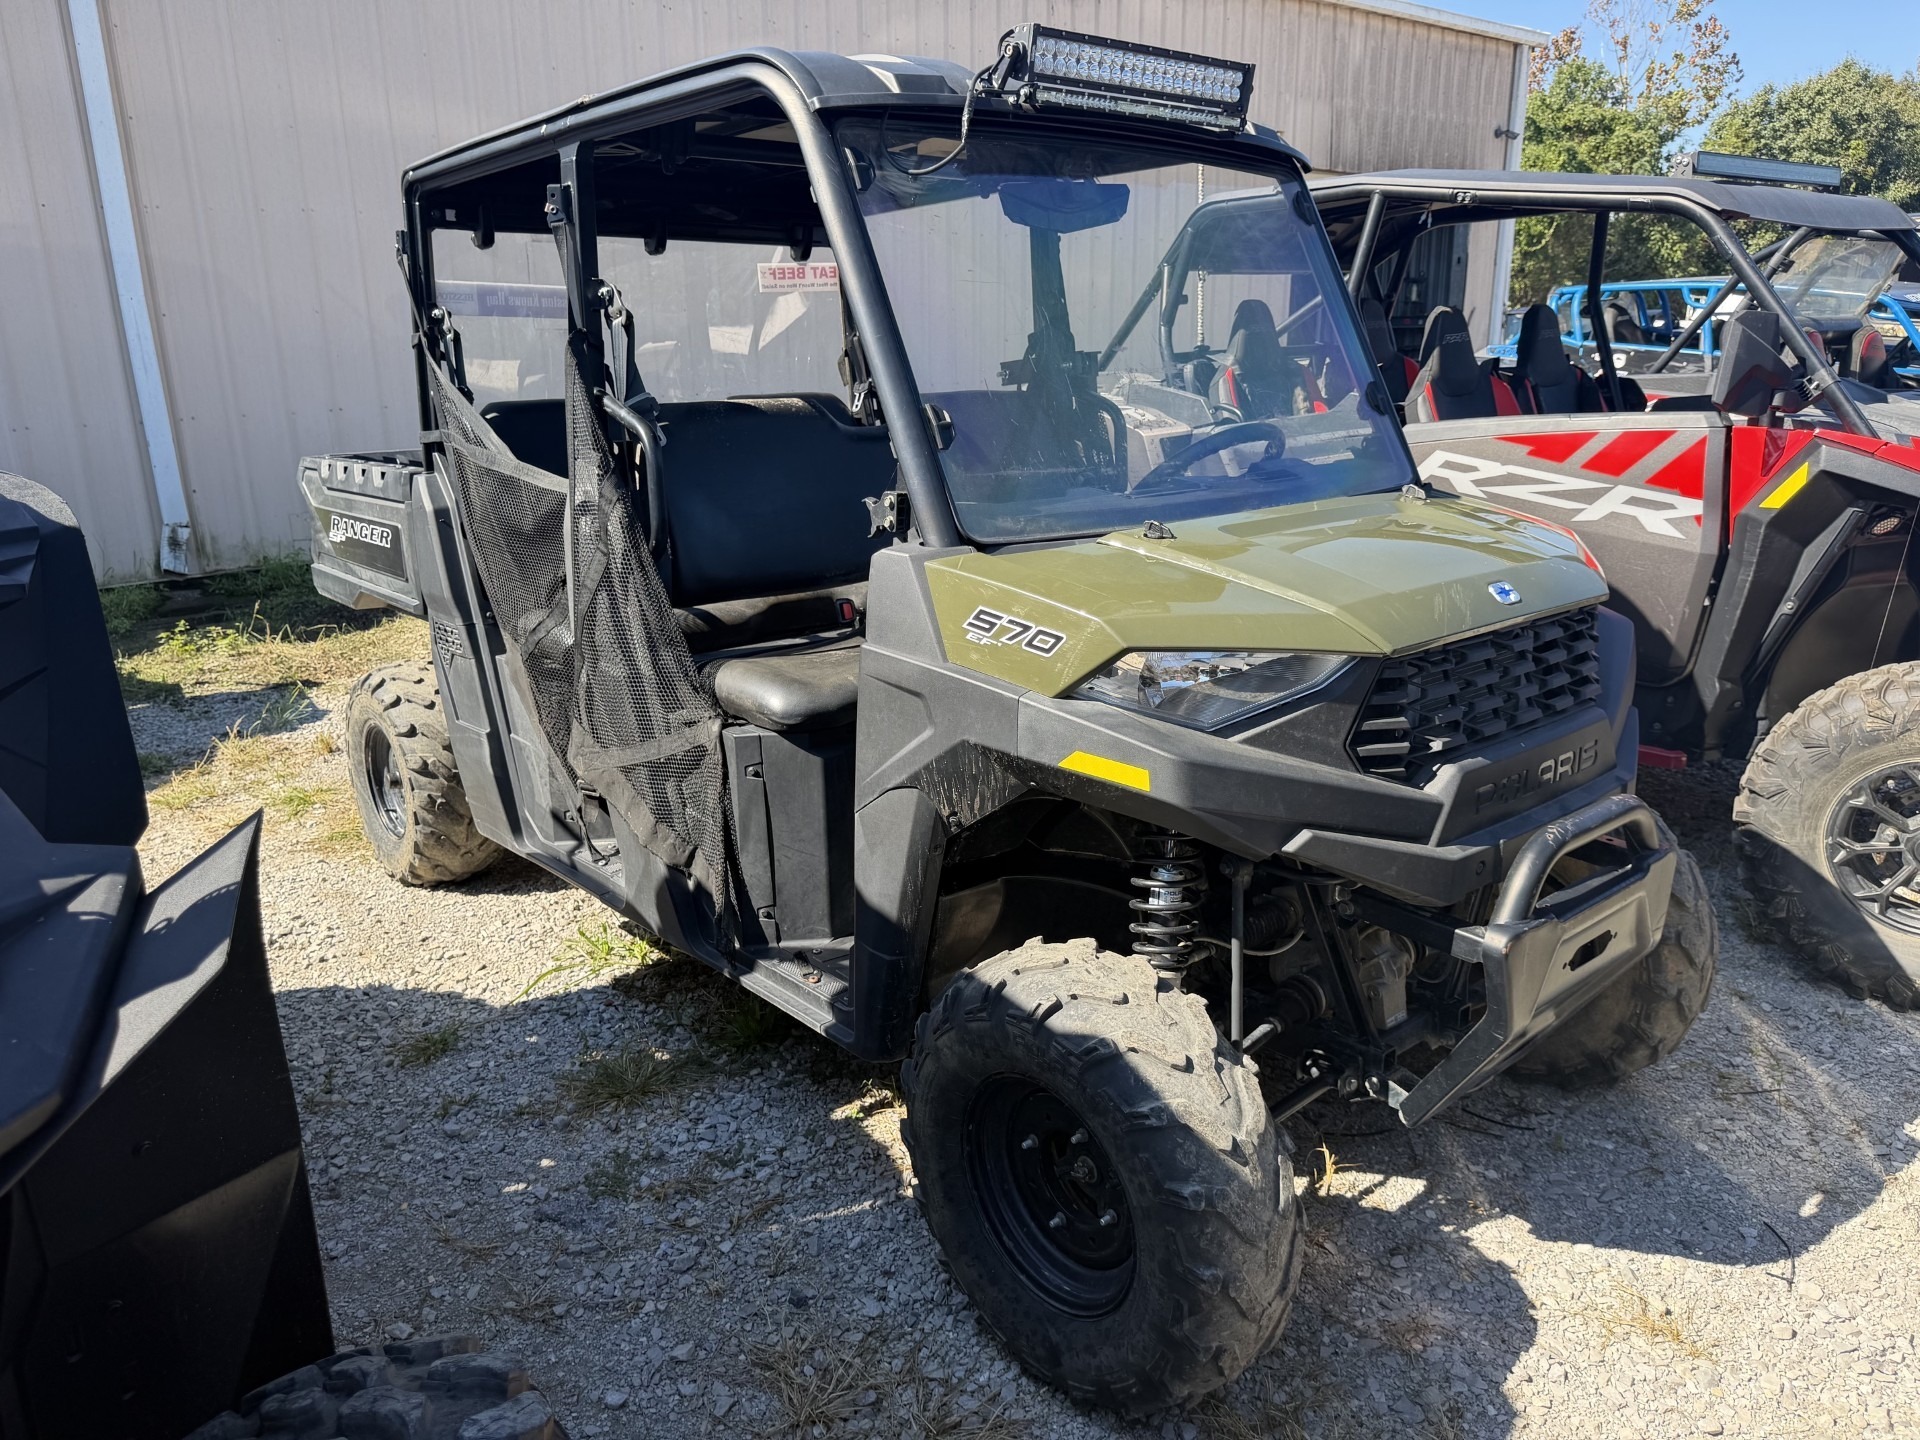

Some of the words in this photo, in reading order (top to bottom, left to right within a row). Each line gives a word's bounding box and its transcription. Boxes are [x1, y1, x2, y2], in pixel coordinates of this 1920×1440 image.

[1416, 449, 1704, 540] RZR
[330, 515, 392, 548] RANGER
[962, 605, 1067, 657] 570
[966, 631, 1002, 647] EF
[1474, 739, 1598, 816] POLARIS
